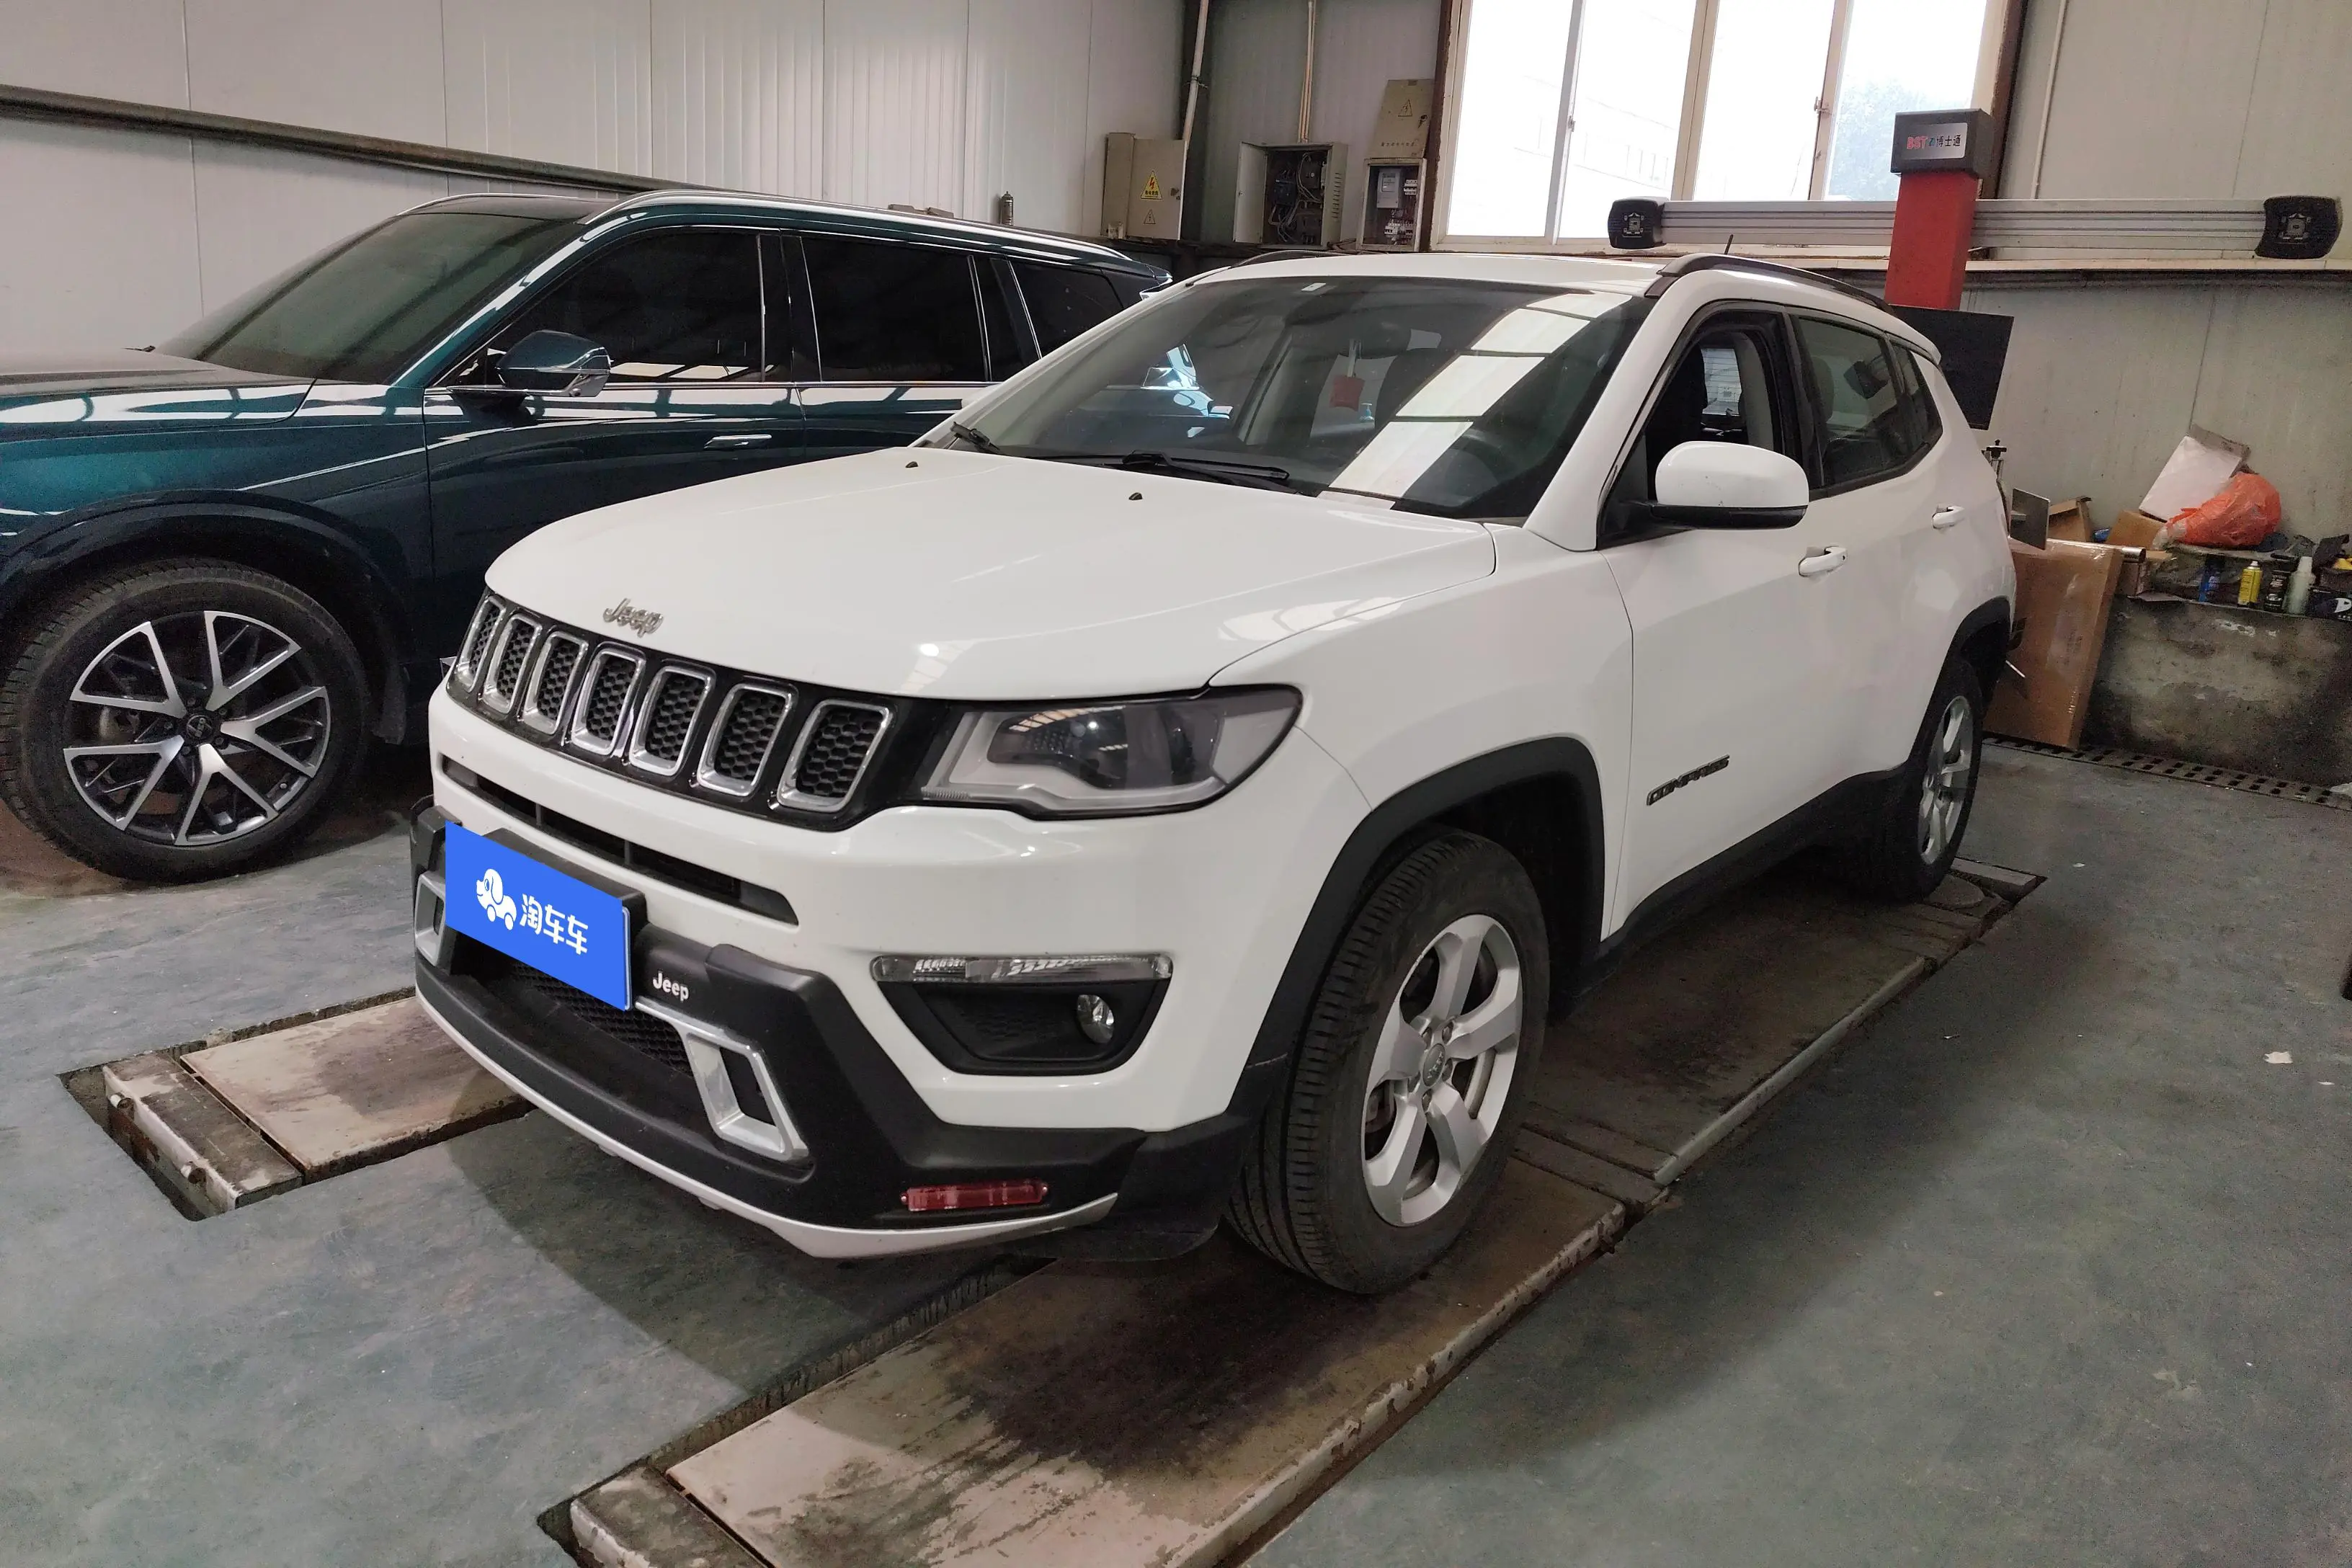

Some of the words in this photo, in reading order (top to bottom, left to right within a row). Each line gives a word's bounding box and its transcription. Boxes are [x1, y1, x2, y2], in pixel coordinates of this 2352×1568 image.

[1907, 135, 1928, 150] BST
[1936, 135, 1961, 147] 博士通
[603, 597, 664, 638] Jeep
[652, 970, 689, 1002] Jeep
